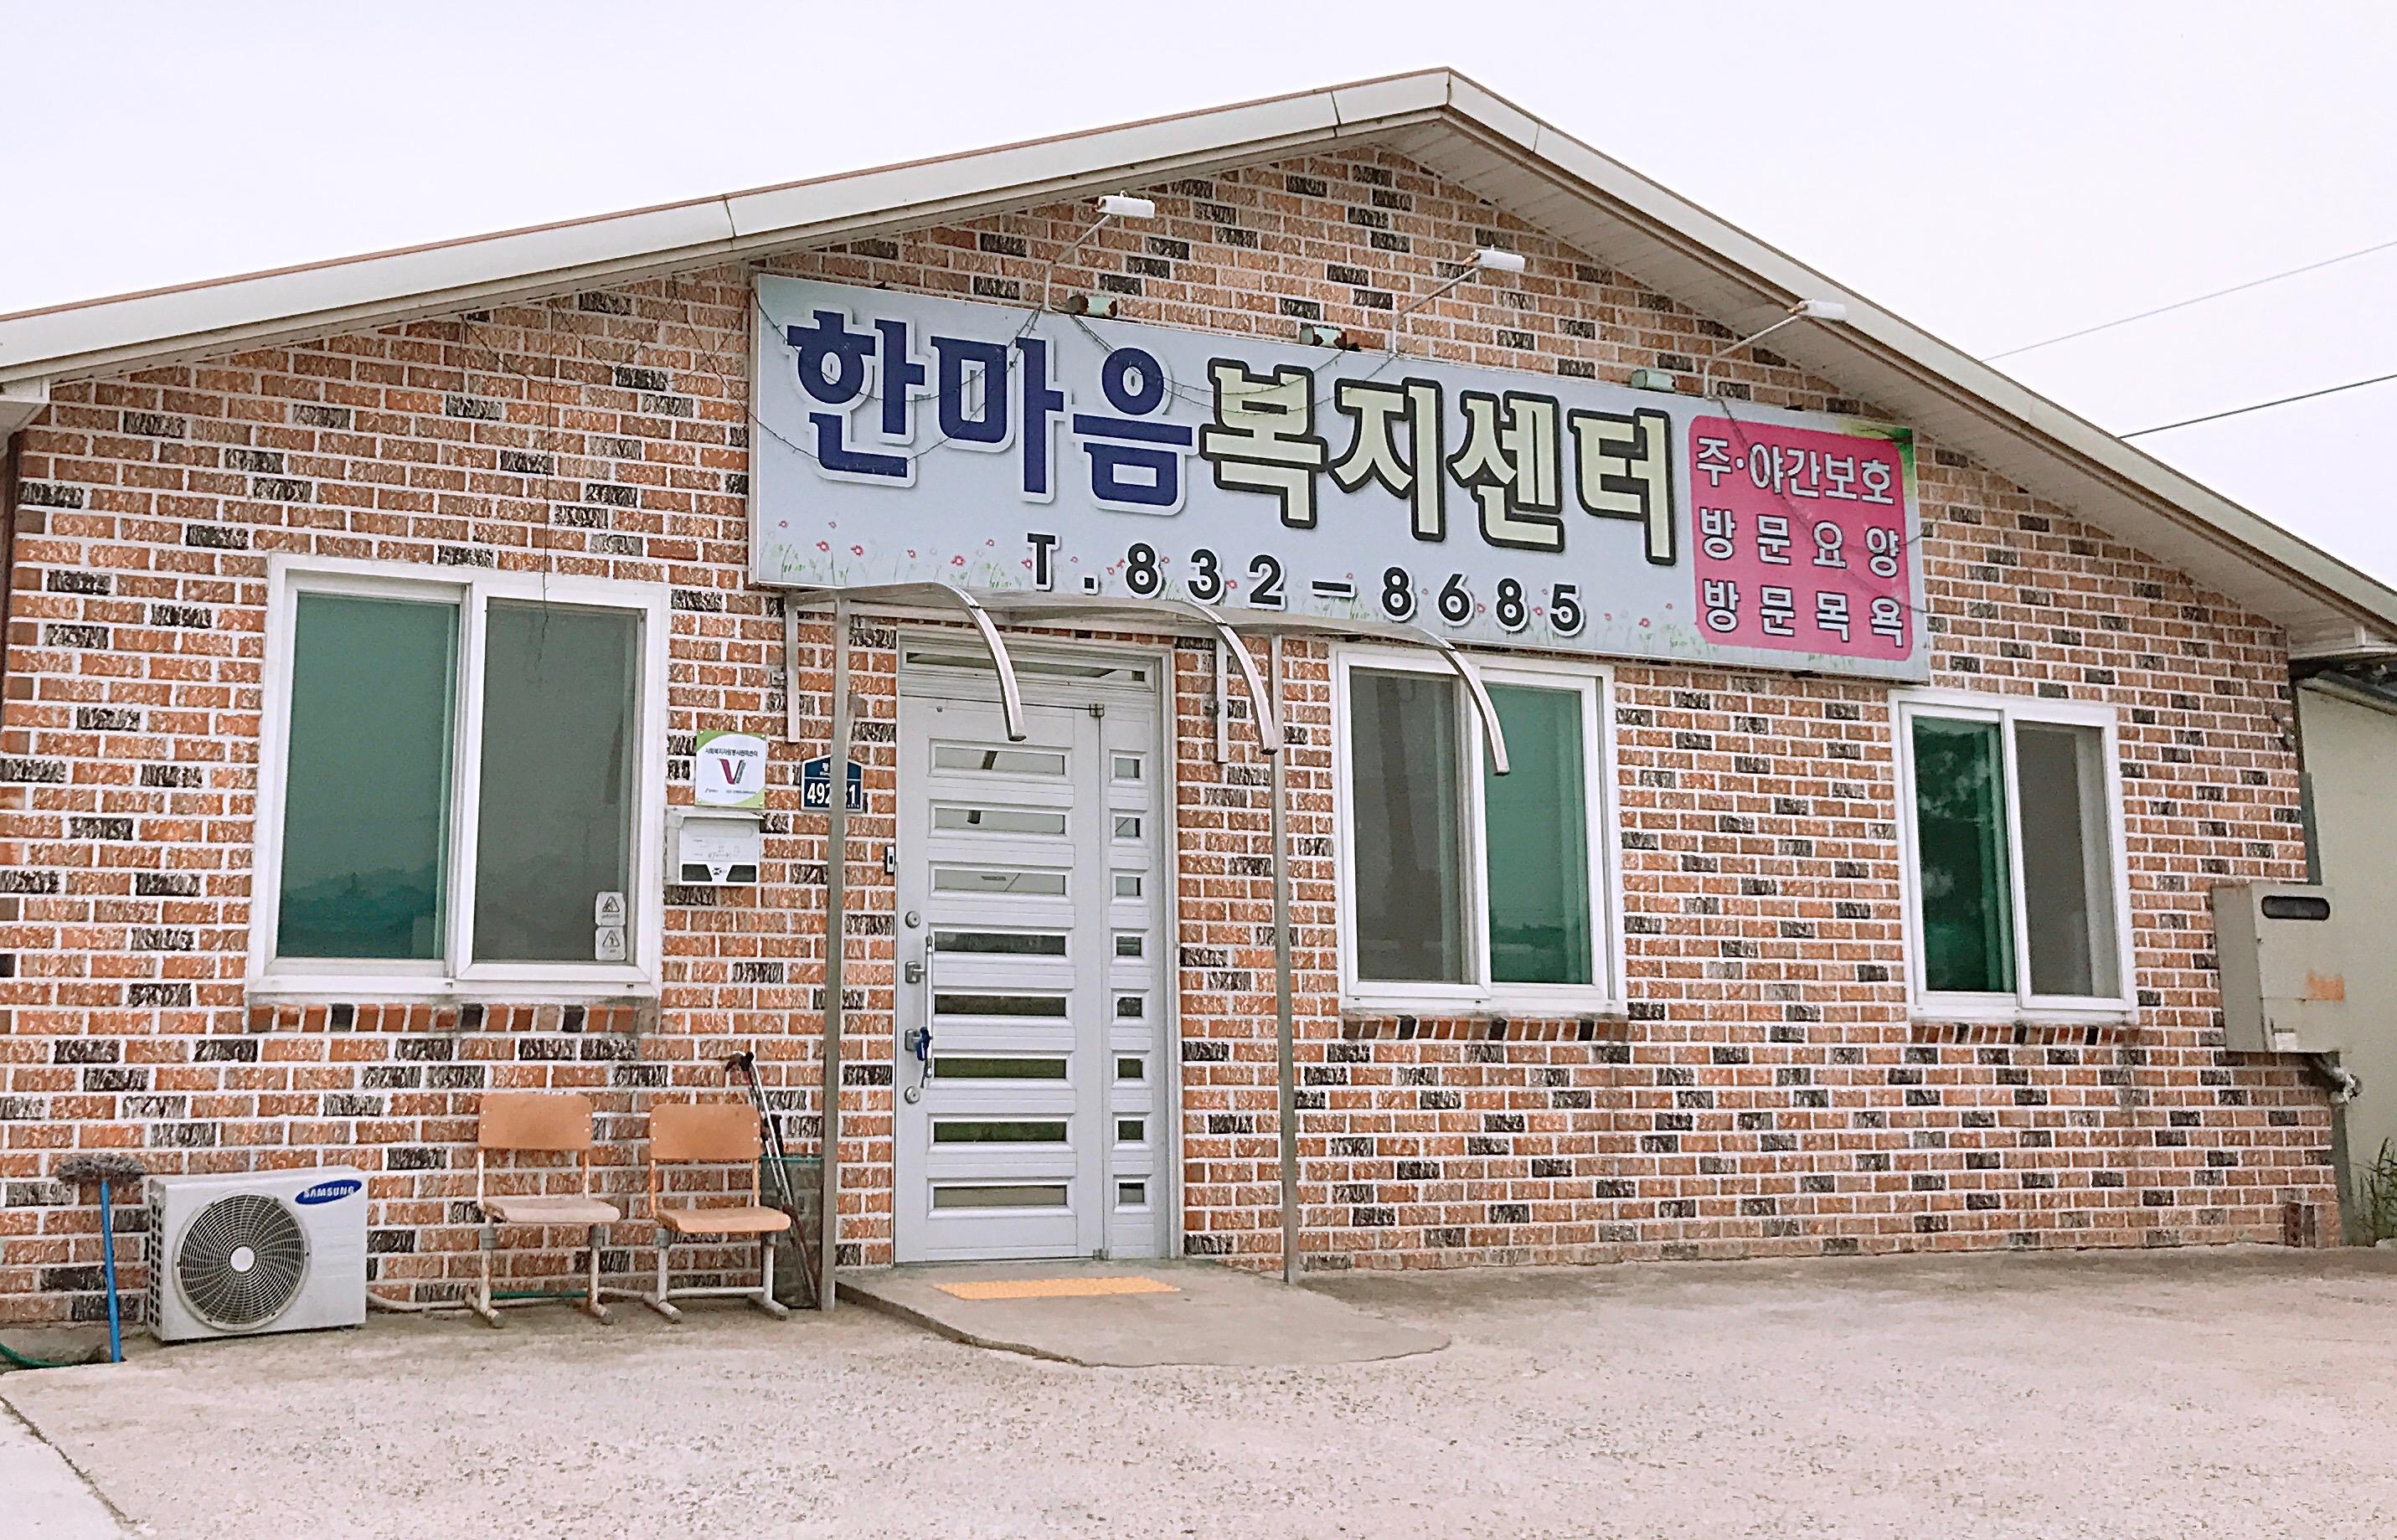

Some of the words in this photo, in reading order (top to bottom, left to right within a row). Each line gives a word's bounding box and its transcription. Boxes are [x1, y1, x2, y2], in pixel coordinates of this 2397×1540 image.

[787, 309, 1193, 507] 한마음
[1199, 358, 1676, 565] 복지센터
[302, 1185, 355, 1199] SAMSUNG
